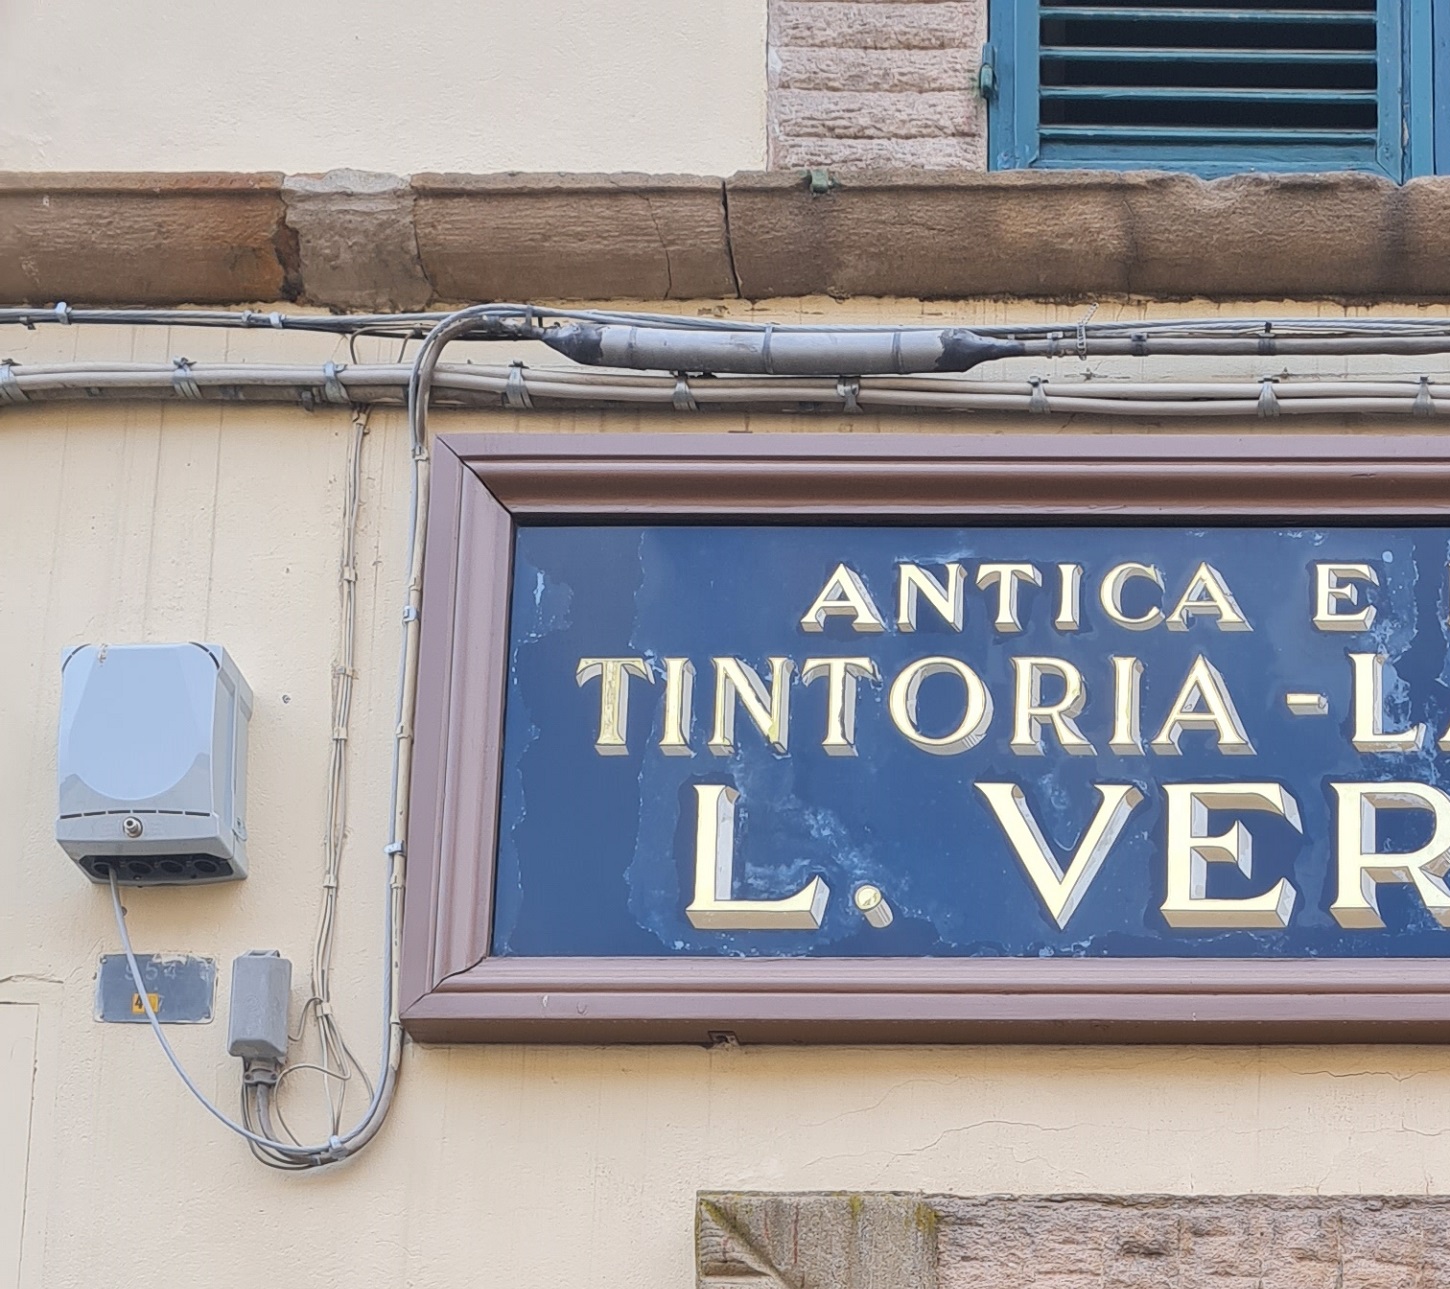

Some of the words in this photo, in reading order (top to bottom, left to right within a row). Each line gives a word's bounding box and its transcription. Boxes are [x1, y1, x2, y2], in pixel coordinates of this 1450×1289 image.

[800, 561, 1253, 632] ANTICA
[1312, 562, 1380, 632] E
[576, 654, 1258, 757] TINTORIA
[685, 784, 894, 930] L.
